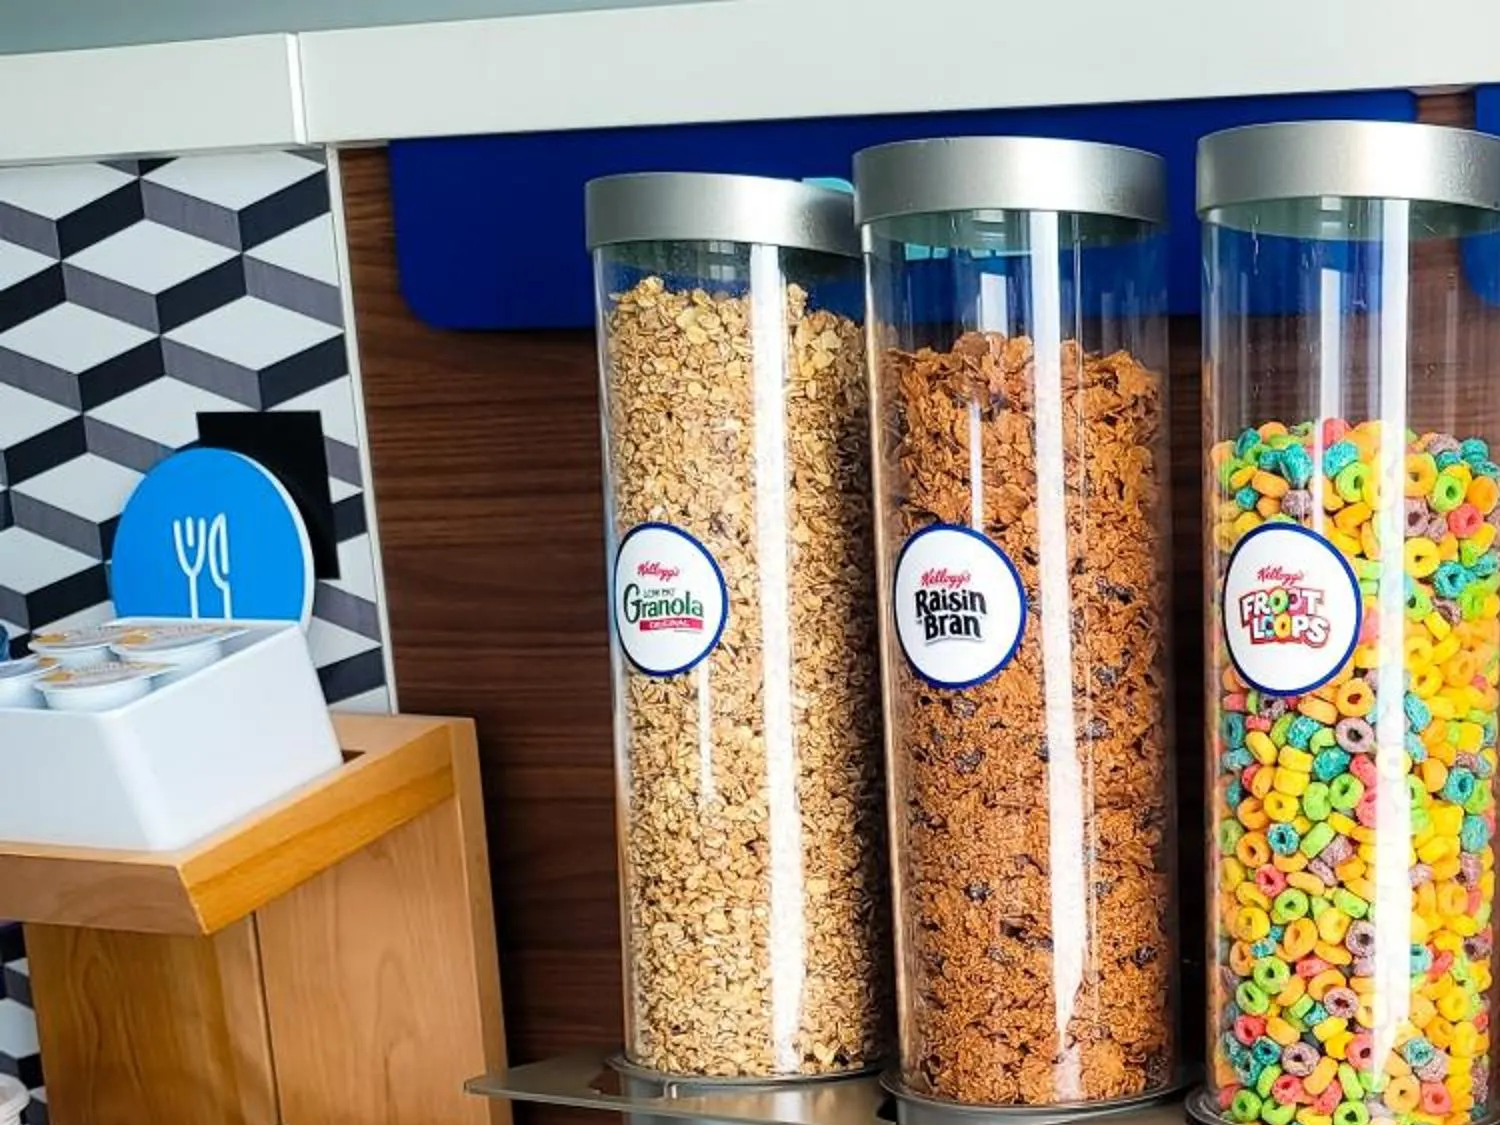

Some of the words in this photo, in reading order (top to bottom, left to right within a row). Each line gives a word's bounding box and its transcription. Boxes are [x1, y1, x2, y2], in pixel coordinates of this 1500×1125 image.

[921, 567, 971, 588] Kellogg's
[1256, 565, 1304, 585] Kellogg's
[623, 583, 704, 624] Granola
[914, 589, 987, 618] Raisin
[1239, 586, 1325, 628] FROOT
[924, 614, 982, 640] Bran
[1250, 613, 1331, 648] LOOPS
